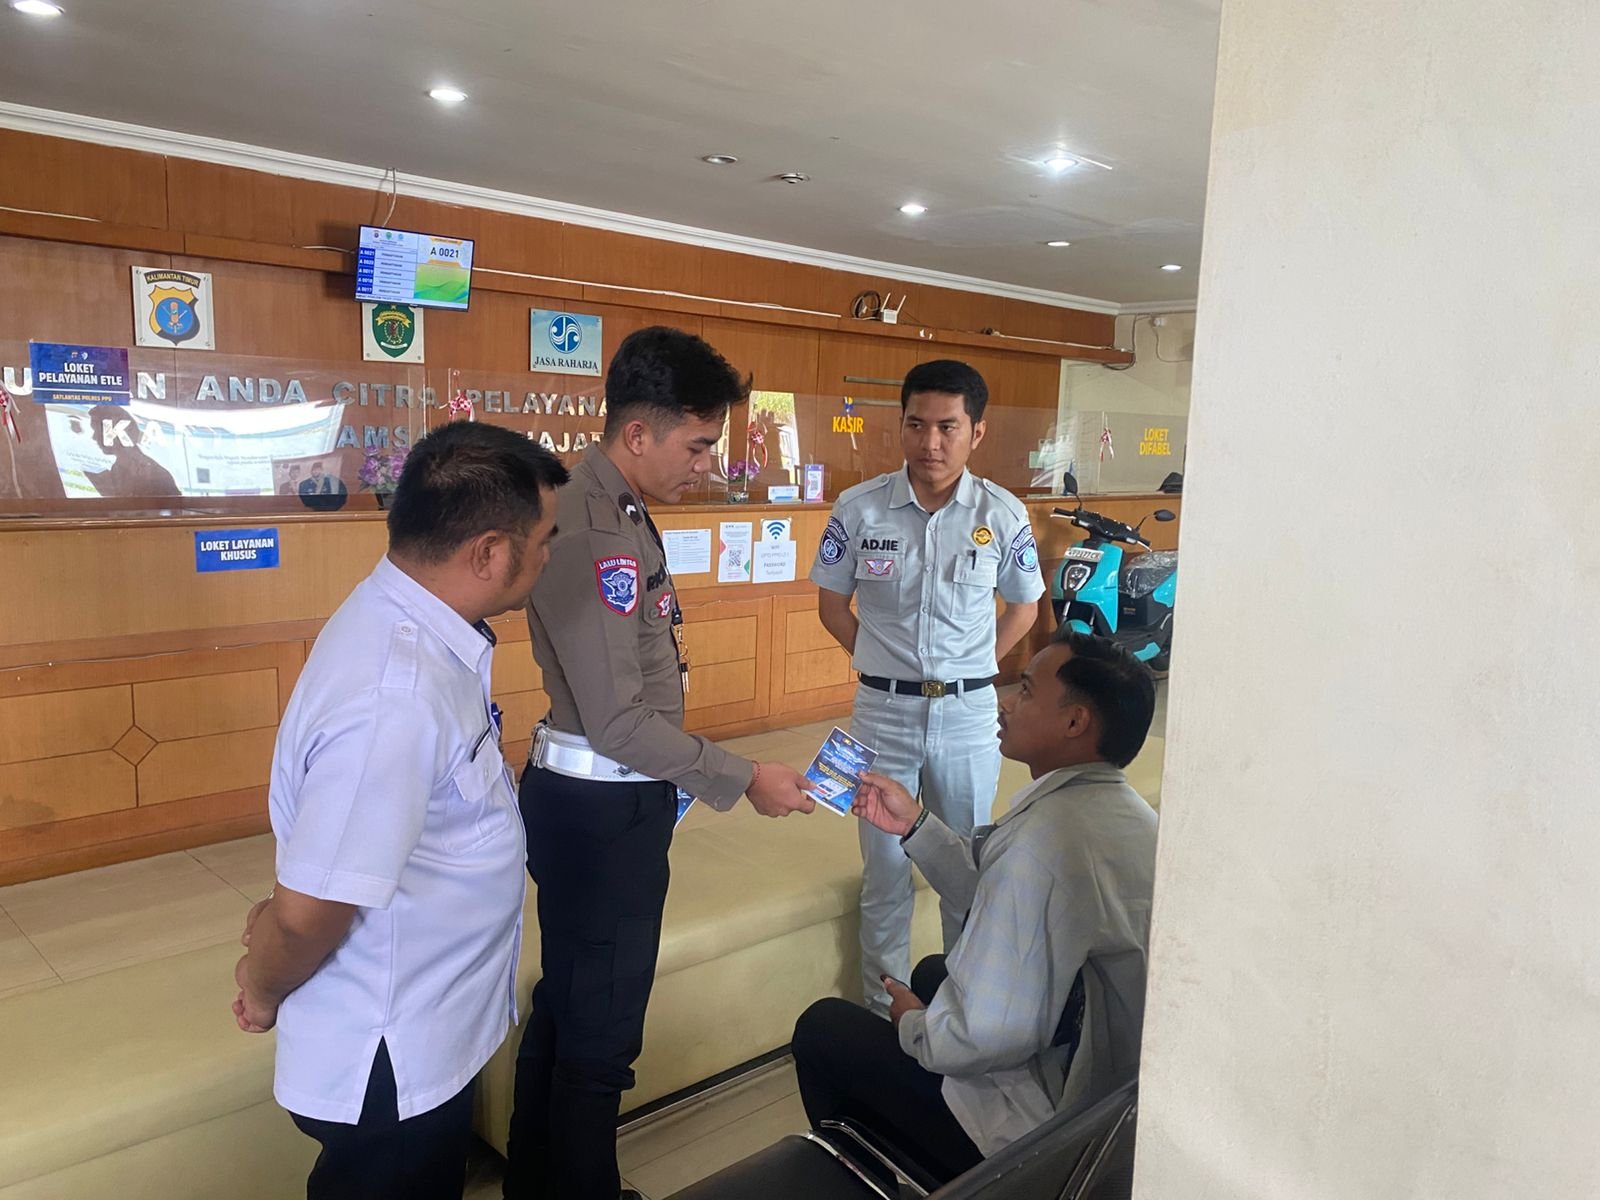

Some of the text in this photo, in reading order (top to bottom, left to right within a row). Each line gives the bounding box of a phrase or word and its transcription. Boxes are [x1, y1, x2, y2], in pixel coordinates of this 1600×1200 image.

[430, 247, 459, 258] A 0021
[146, 272, 199, 287] KALIMANTAN TIMUR
[64, 362, 94, 374] LOKET
[534, 356, 599, 370] JASA RAHARJA
[39, 372, 123, 386] PELAYANAN ETLE
[196, 375, 308, 404] ANDA
[333, 381, 440, 409] CITRA
[832, 416, 864, 433] KASIR
[1144, 428, 1169, 441] LOKET
[1140, 441, 1171, 455] DIFABEL
[200, 538, 274, 551] LOKET LAYANAN
[860, 538, 899, 551] ADJIE
[220, 549, 257, 561] KHUSUS
